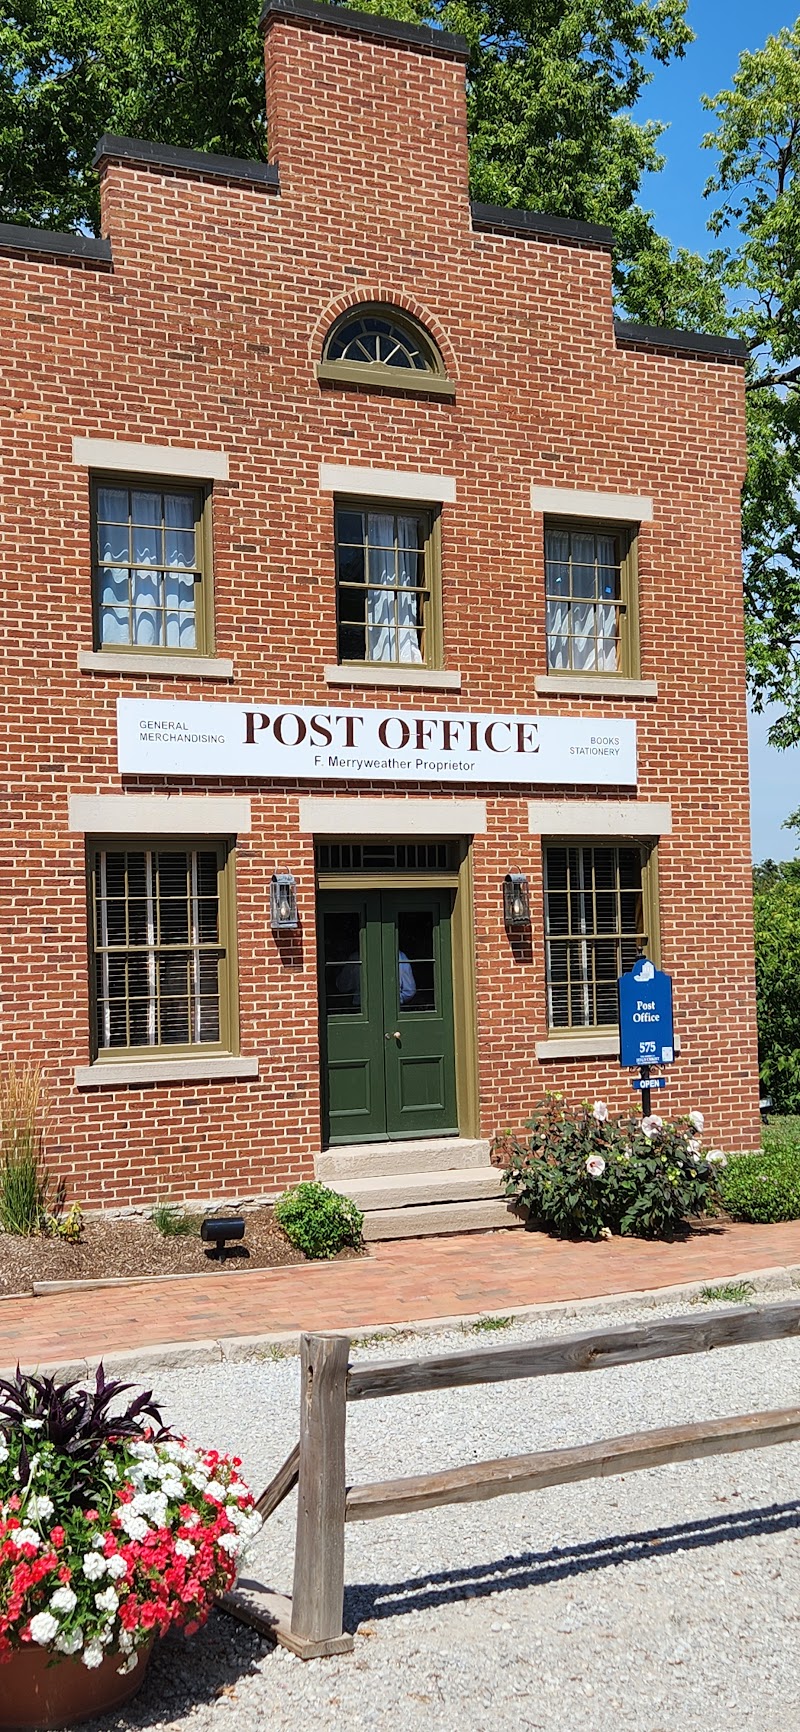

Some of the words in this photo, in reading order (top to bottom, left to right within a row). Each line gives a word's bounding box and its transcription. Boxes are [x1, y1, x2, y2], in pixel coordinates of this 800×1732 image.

[139, 720, 189, 731] GENERAL
[242, 711, 364, 748] POST
[378, 717, 541, 753] OFFICE
[139, 732, 225, 744] MERCHANDISING
[590, 736, 620, 746] BOOKS
[569, 746, 620, 756] STATIONERY
[314, 755, 325, 767] F.
[328, 756, 412, 771] Merryweather
[415, 758, 476, 772] Proprietor
[637, 1001, 655, 1010] Post
[633, 1012, 660, 1022] Office
[639, 1041, 656, 1053] 575
[639, 1080, 660, 1089] OPEN
